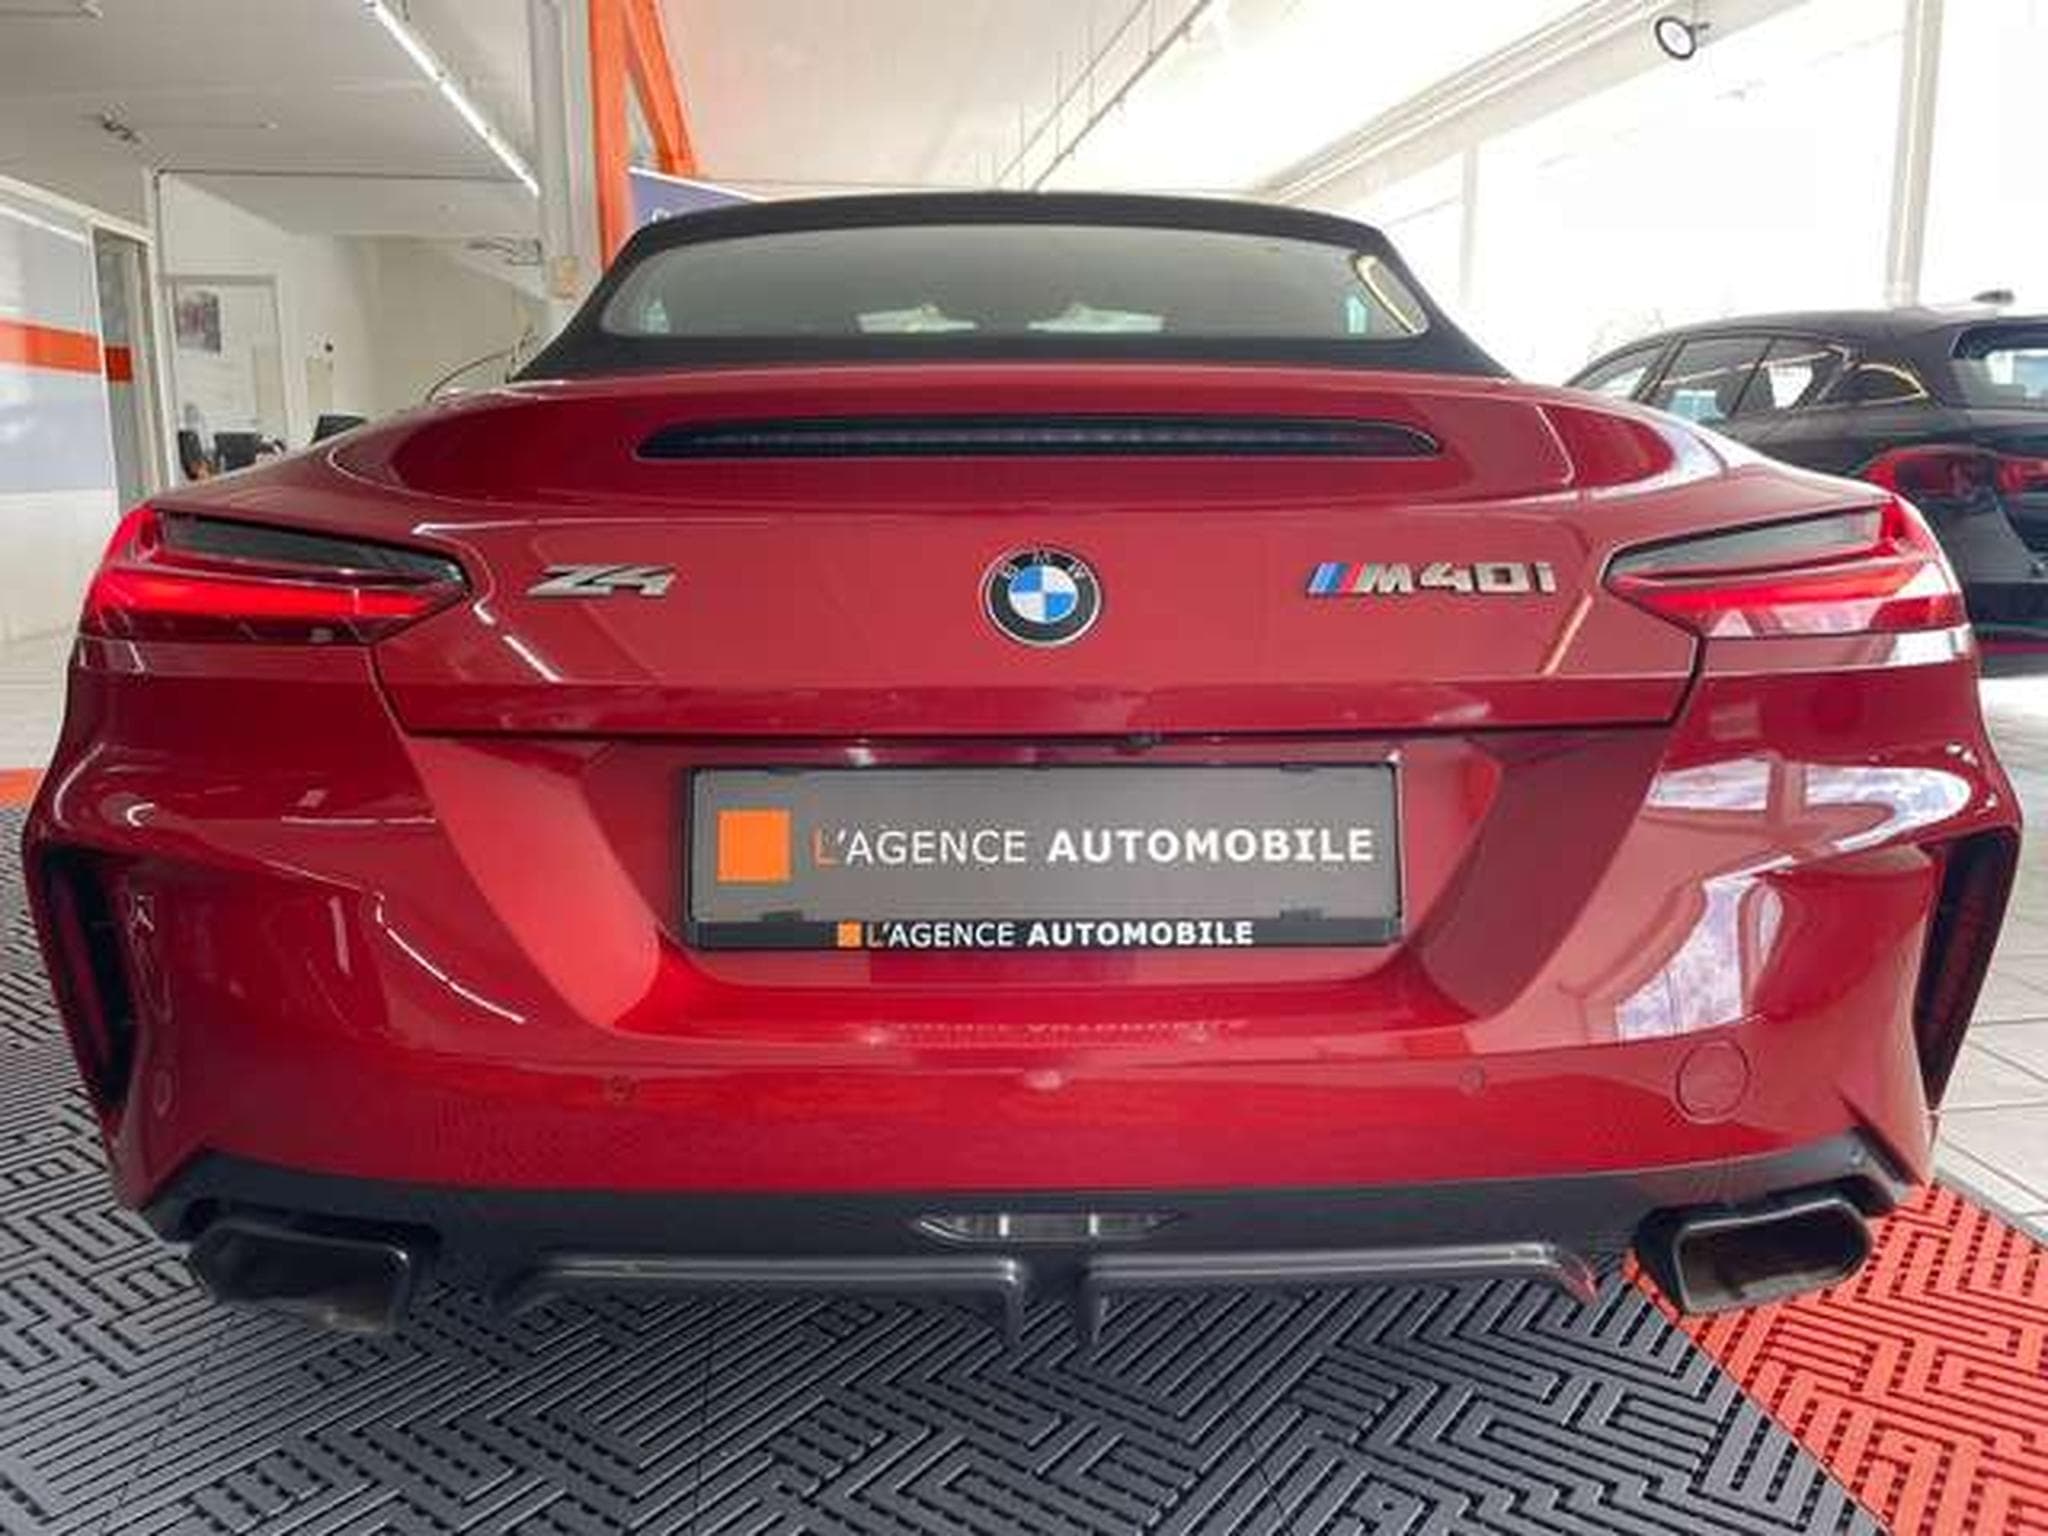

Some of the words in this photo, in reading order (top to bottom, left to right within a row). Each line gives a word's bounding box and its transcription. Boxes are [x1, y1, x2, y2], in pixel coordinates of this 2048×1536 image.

[526, 563, 676, 597] Z4
[998, 551, 1086, 580] BMW
[813, 827, 1027, 867] L'AGENCE
[1047, 827, 1375, 863] AUTOMOBILE
[867, 921, 1013, 947] L'AGENCE
[1026, 921, 1253, 947] AUTOMOBILE
